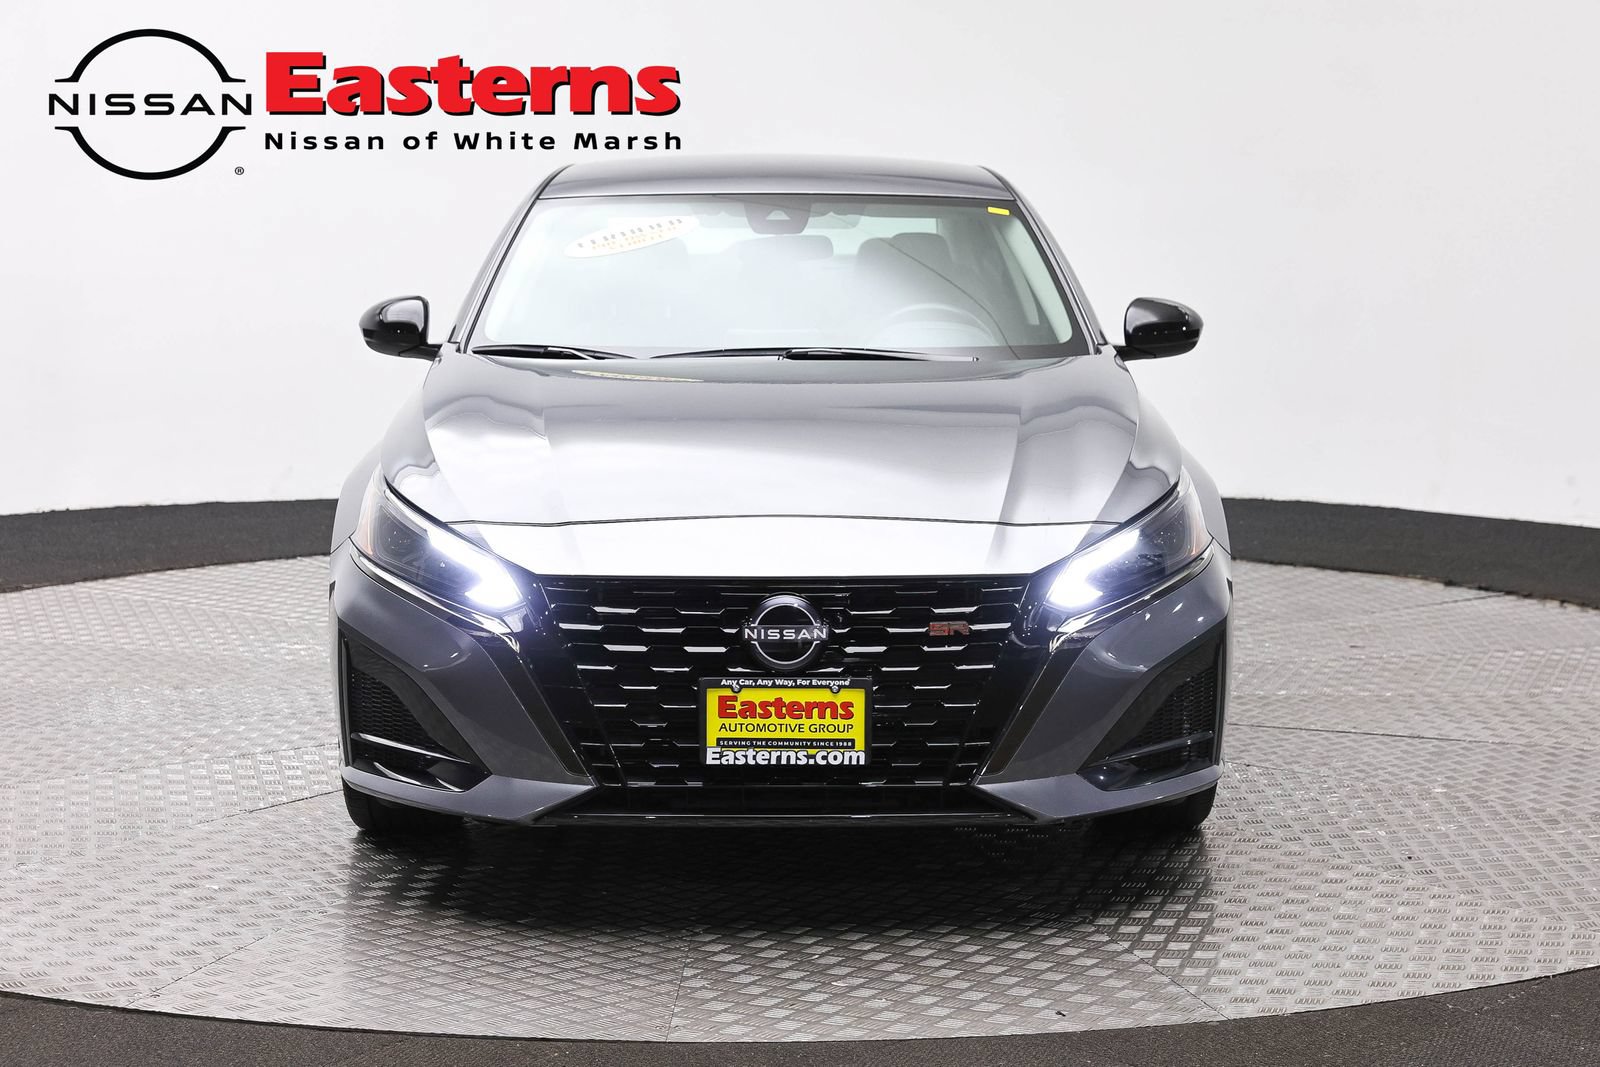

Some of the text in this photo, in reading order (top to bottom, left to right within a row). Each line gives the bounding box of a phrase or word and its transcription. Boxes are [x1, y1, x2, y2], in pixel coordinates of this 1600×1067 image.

[744, 628, 828, 640] NISSAN
[721, 679, 738, 688] Any
[739, 679, 756, 687] Car,
[757, 679, 773, 687] Any
[774, 679, 796, 687] Way,
[812, 679, 850, 687] Everyone
[717, 695, 855, 720] Easterns
[718, 722, 854, 734] AUTOMOTIVE GROUP
[706, 747, 866, 765] Easterns.com
